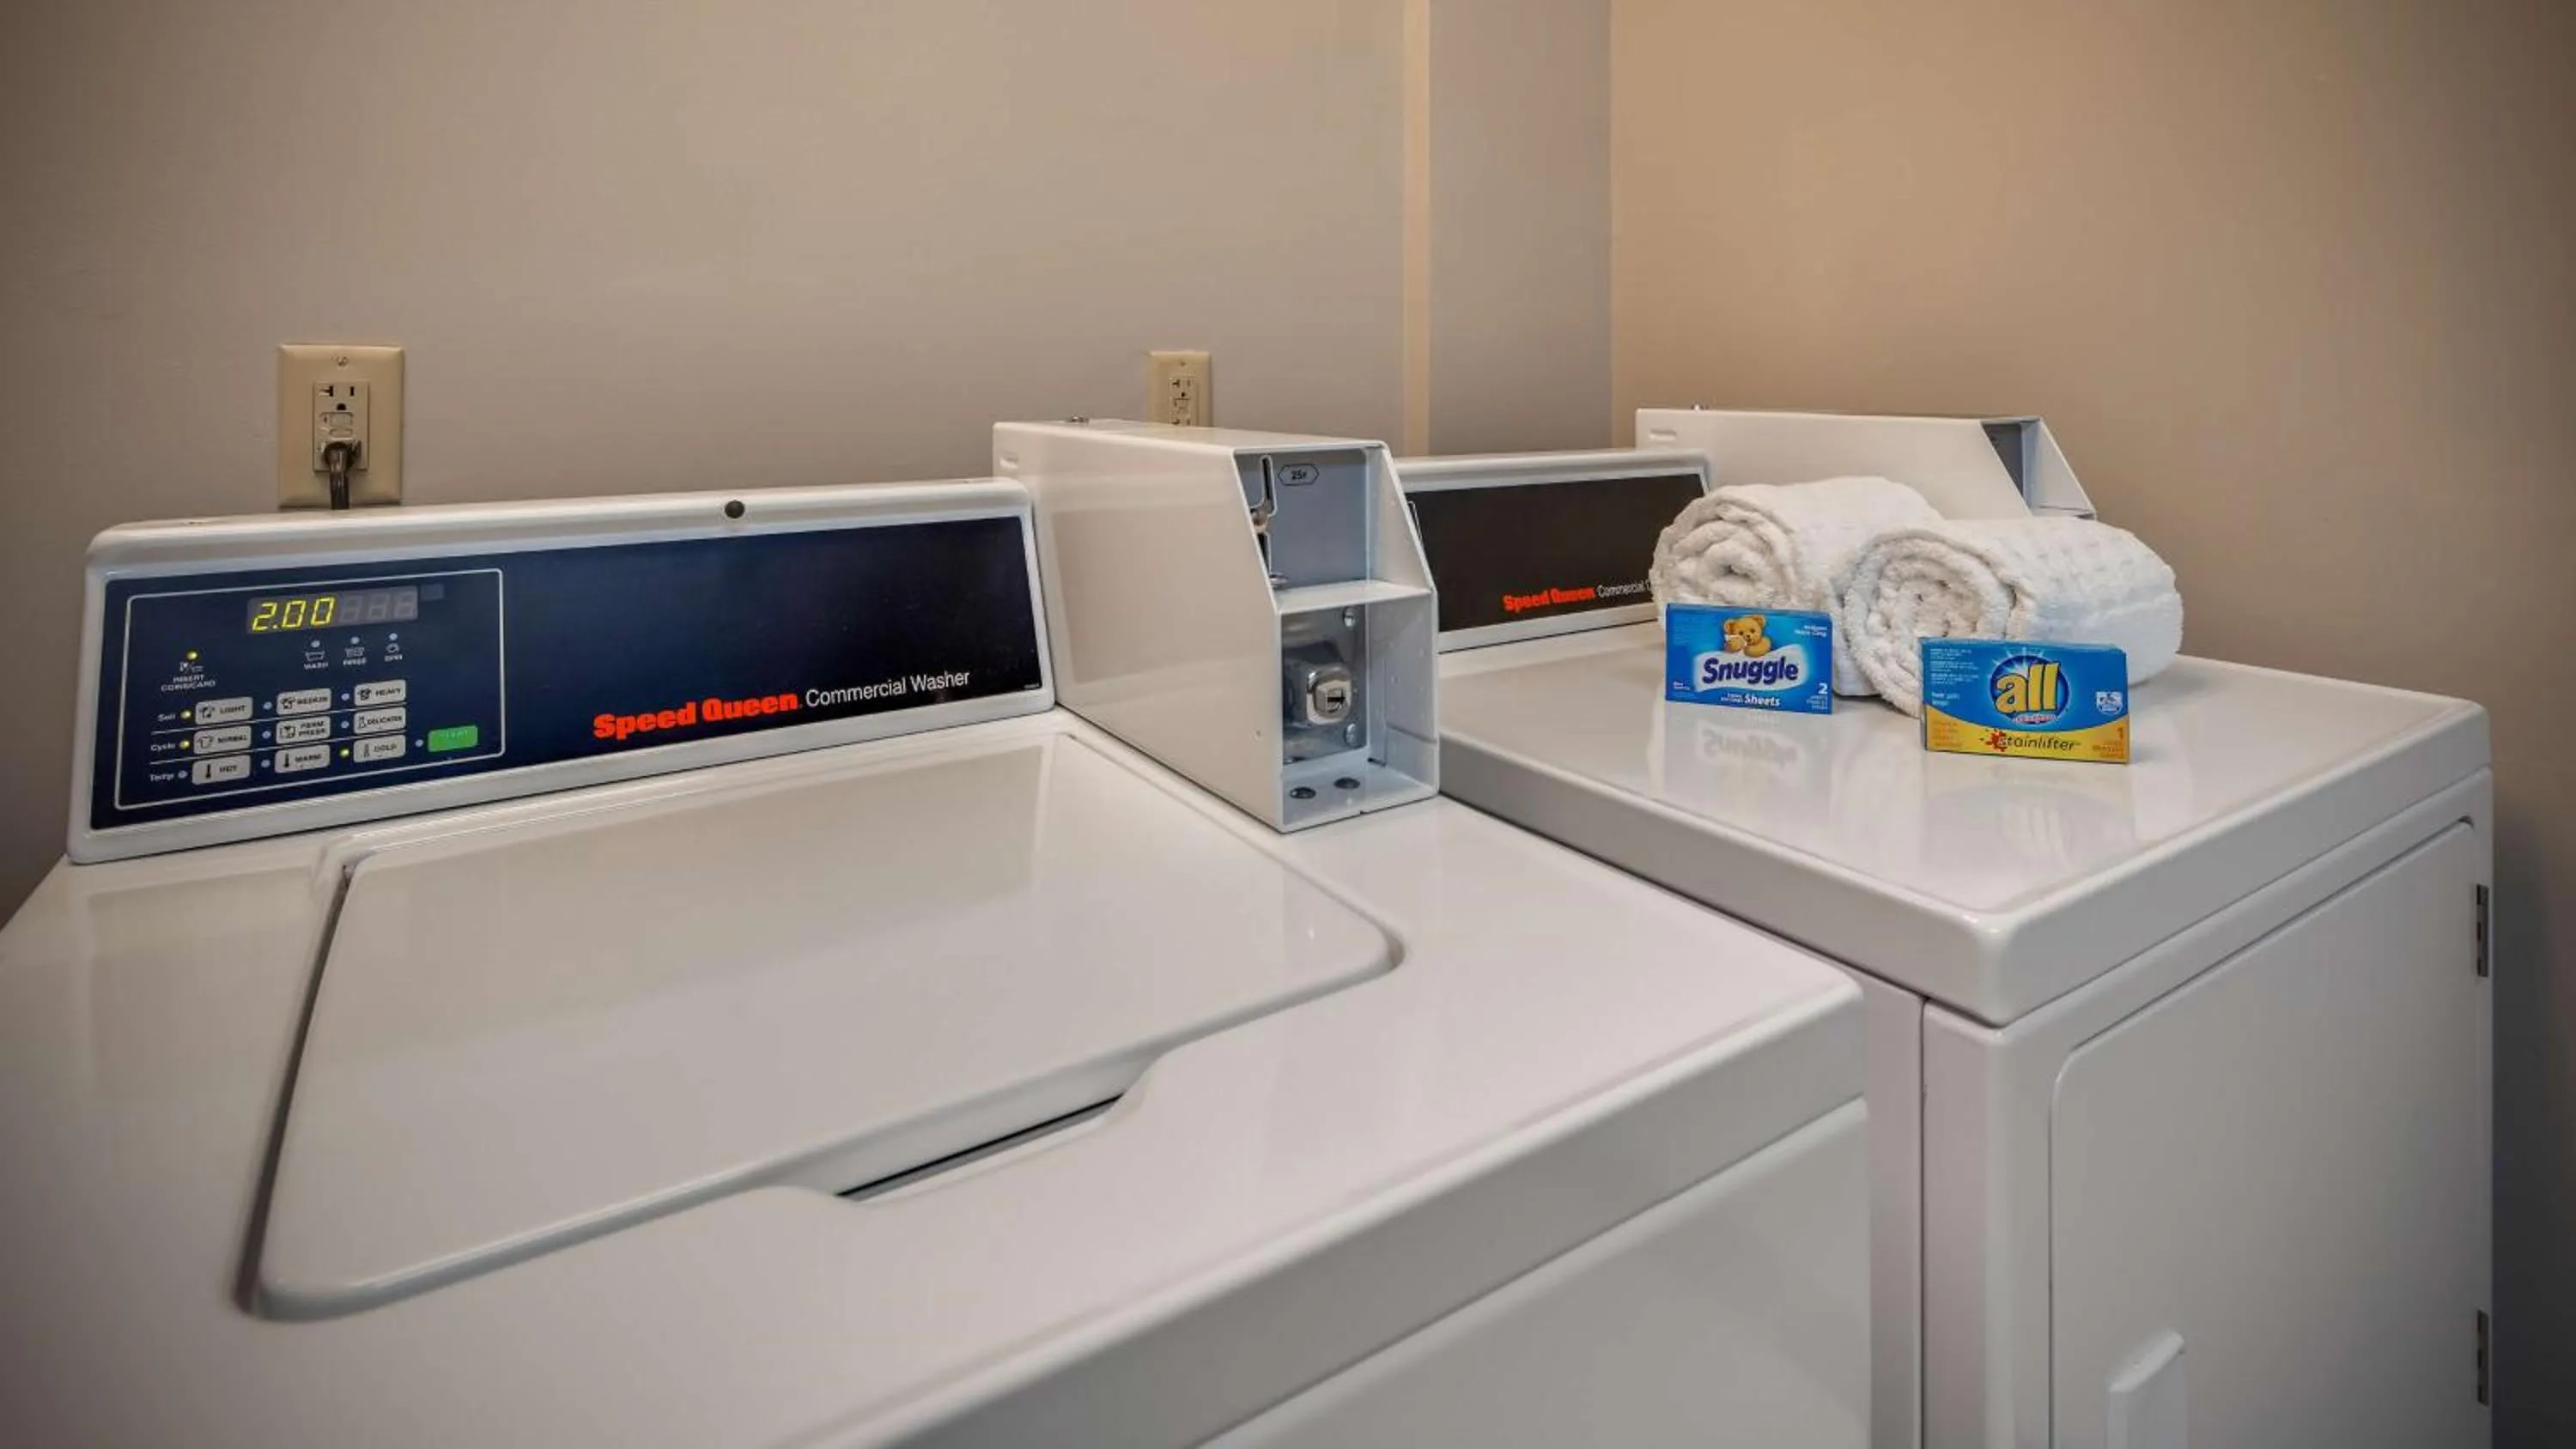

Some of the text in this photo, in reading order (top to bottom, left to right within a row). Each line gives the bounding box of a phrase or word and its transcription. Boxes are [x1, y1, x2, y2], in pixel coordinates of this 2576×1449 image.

[1504, 590, 1550, 613] Speed
[1551, 587, 1595, 603] Queen
[251, 596, 336, 632] 2.00
[173, 674, 204, 683] INSERT
[1702, 656, 1799, 685] Snuggle
[374, 688, 402, 697] HEAVY
[1818, 683, 1828, 694] 2
[1995, 662, 2060, 714] all
[593, 669, 970, 740] Speed Queen Commercial Washer
[1744, 693, 1780, 706] Sheets
[219, 705, 246, 714] LIGHT
